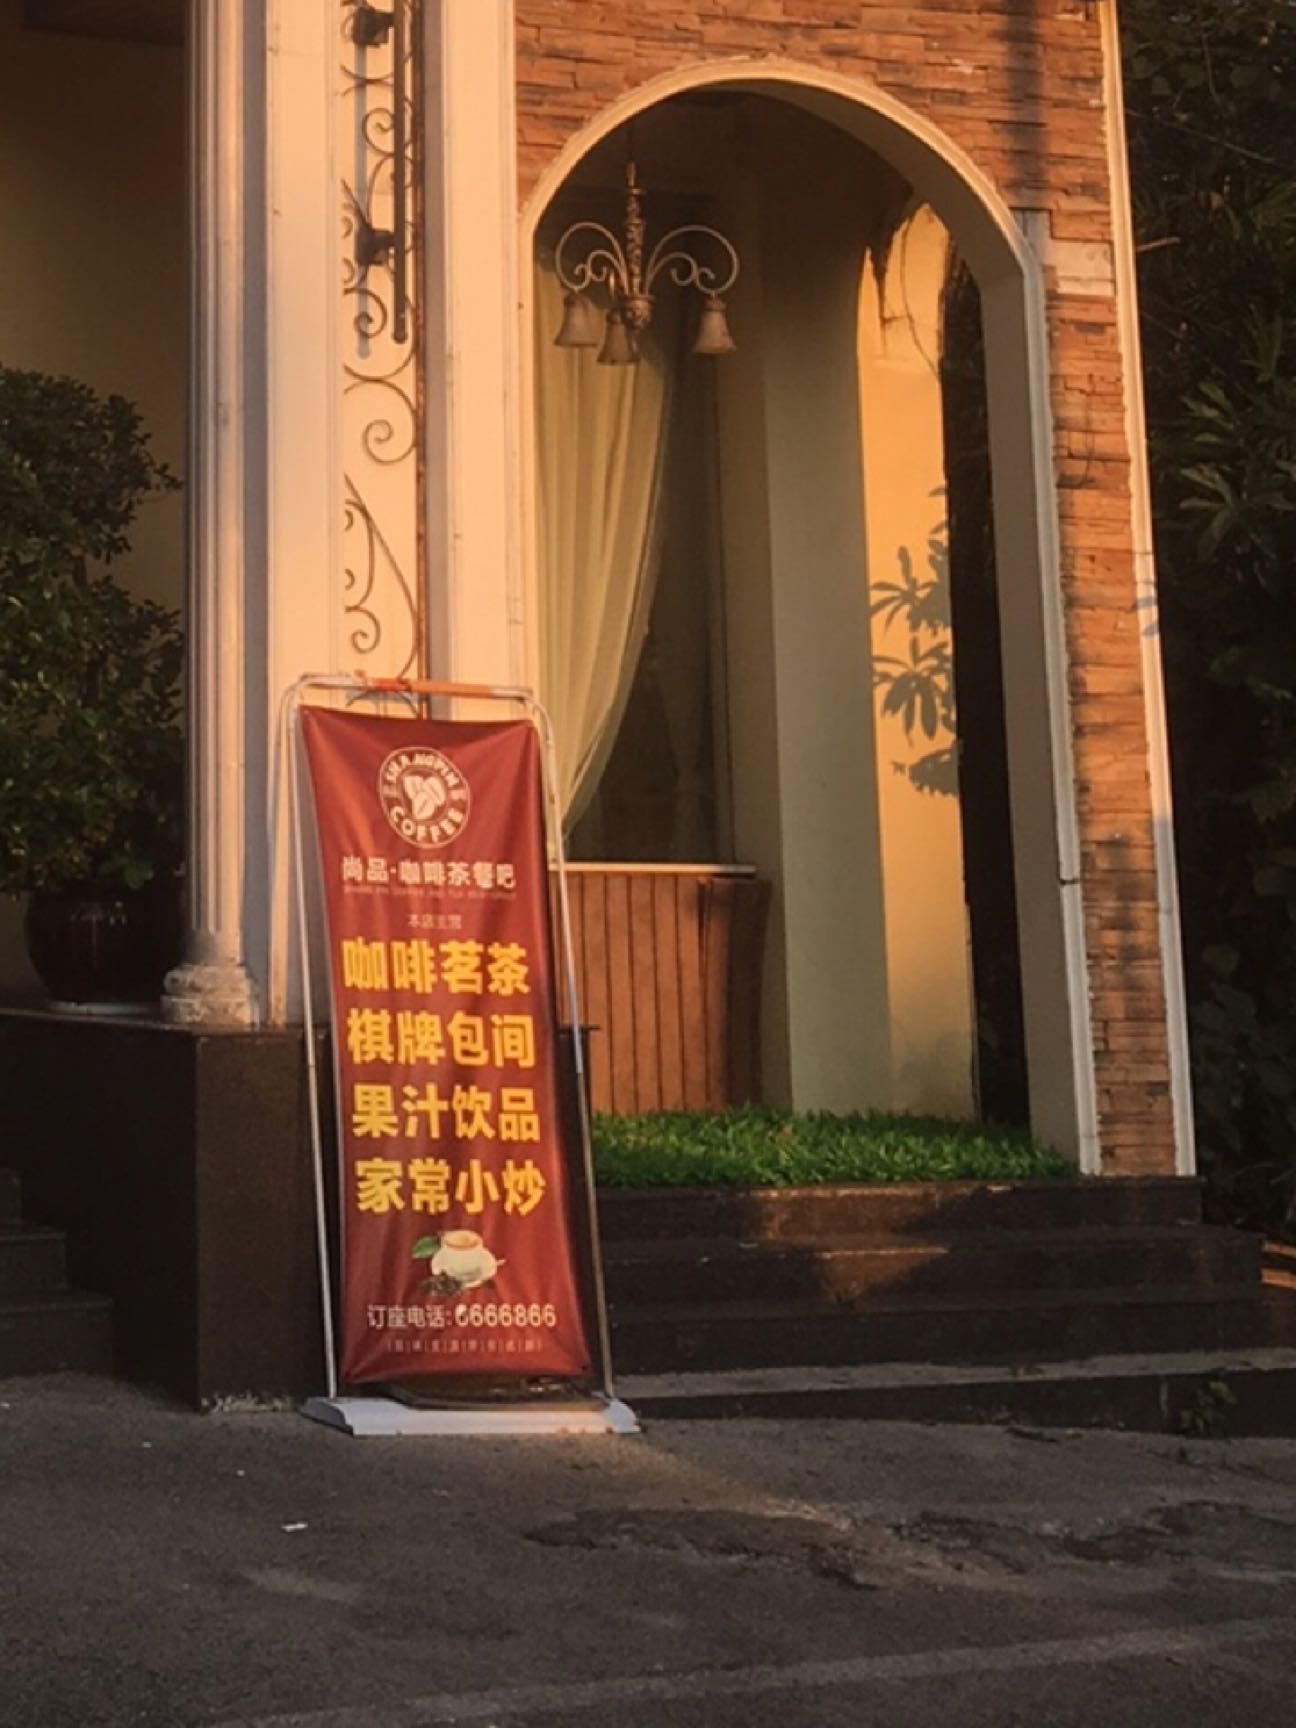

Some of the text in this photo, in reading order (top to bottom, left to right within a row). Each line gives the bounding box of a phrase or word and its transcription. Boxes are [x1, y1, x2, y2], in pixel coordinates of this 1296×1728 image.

[390, 805, 466, 843] COFFEE
[342, 936, 531, 996] 咖啡茗茶
[347, 1007, 536, 1068] 棋牌包间
[352, 1082, 541, 1142] 果汁饮品
[356, 1157, 547, 1216] 家常小炒
